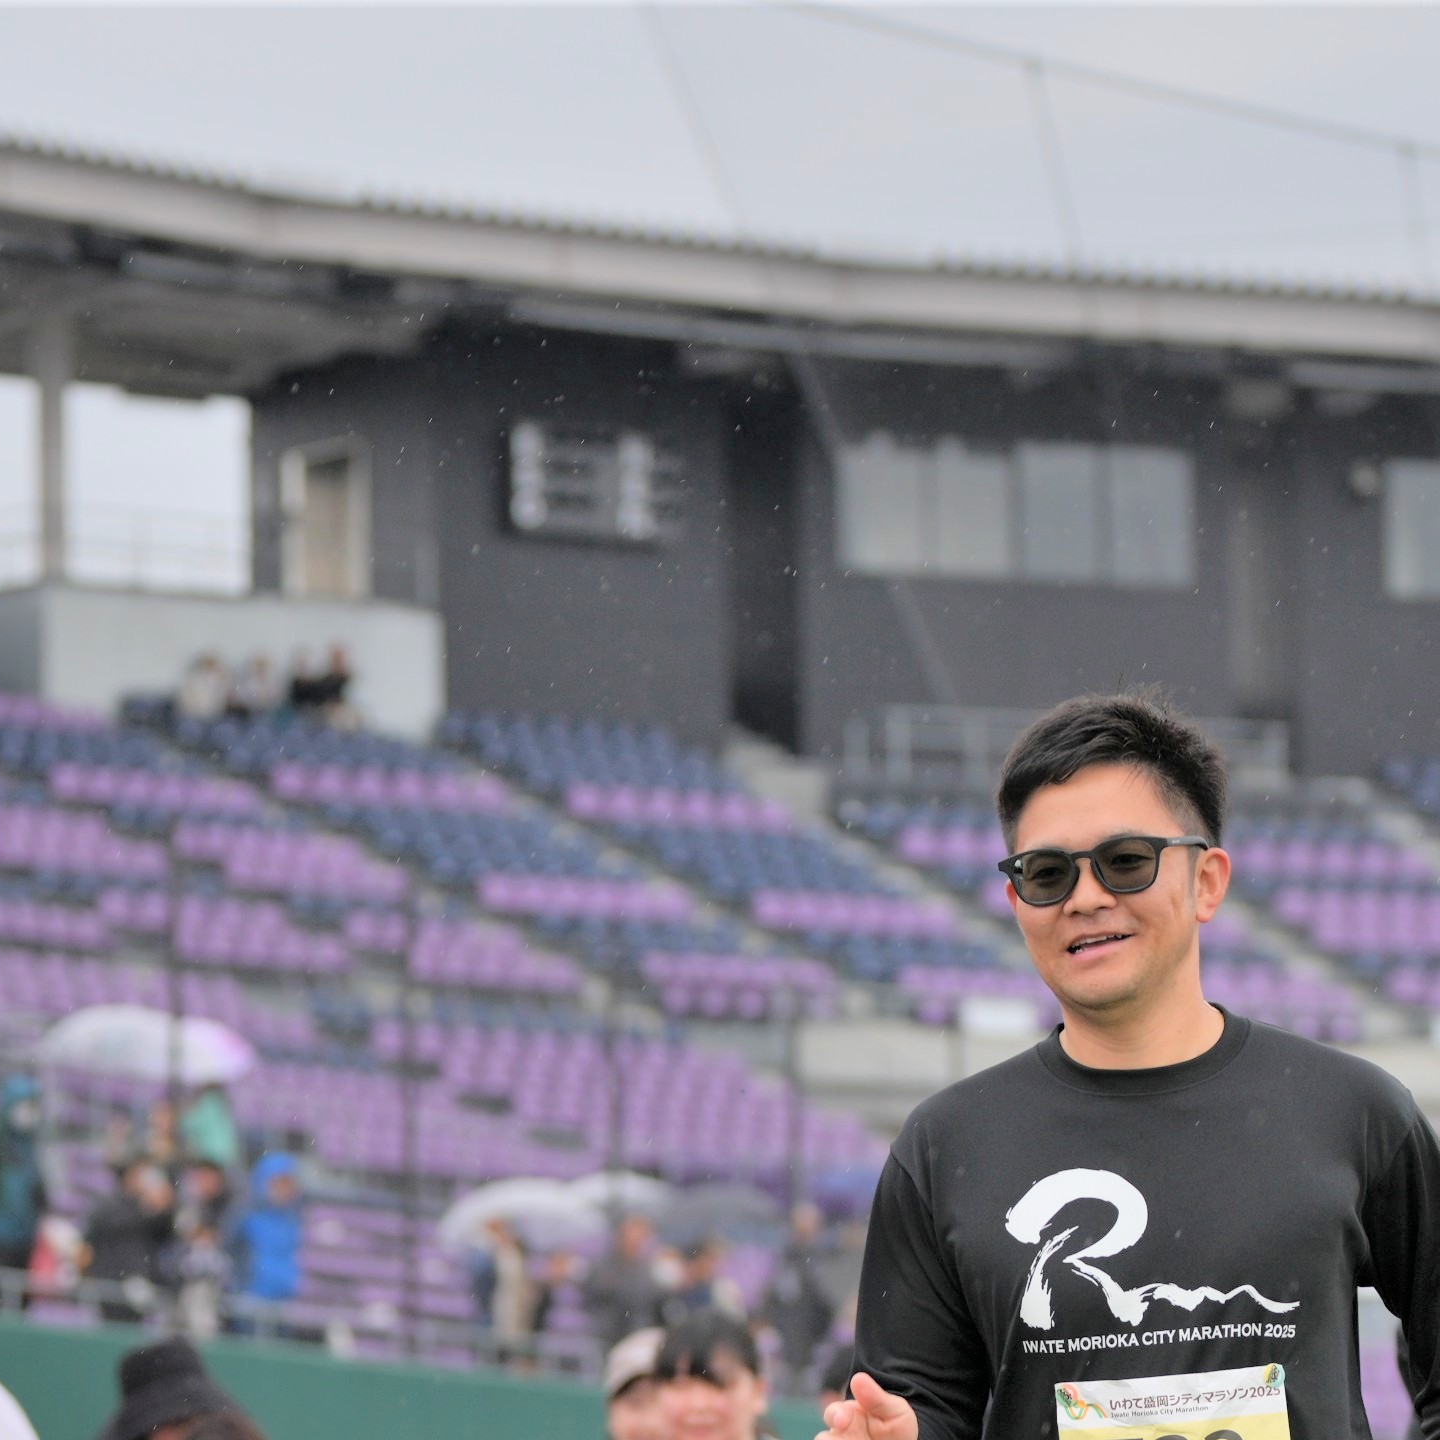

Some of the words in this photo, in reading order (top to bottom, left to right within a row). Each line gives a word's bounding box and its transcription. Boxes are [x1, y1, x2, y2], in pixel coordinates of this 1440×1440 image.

[1022, 1339, 1065, 1354] IWATE
[1068, 1332, 1140, 1352] MORIOKA
[1142, 1329, 1176, 1346] CITY
[1178, 1322, 1262, 1342] MARATHON
[1264, 1323, 1296, 1339] 2025
[1110, 1385, 1281, 1411] いわて盛岡シティマラソン2025
